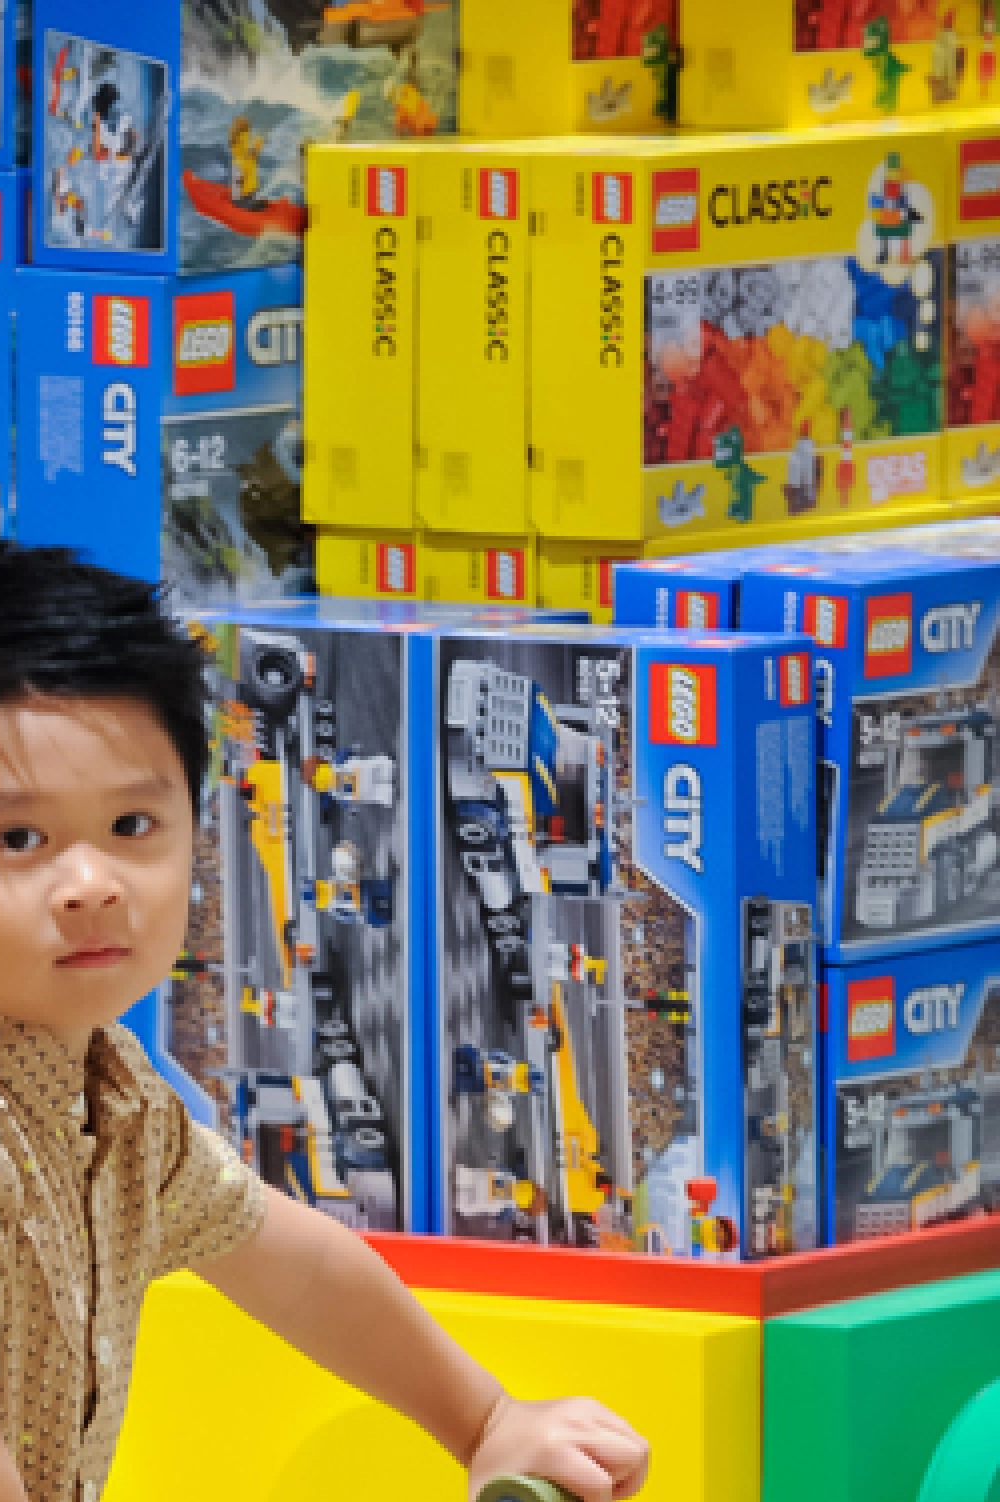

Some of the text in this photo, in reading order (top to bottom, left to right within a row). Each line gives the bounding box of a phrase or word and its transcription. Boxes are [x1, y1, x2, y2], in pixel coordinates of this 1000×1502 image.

[378, 167, 397, 214] LEGO
[490, 170, 509, 217] LEGO
[603, 174, 622, 221] LEGO
[178, 306, 304, 368] LEGO CIT
[102, 297, 138, 477] LEGO CITY
[170, 433, 226, 474] 6-12
[687, 591, 710, 632] LEG
[920, 602, 982, 653] CITY
[597, 658, 621, 727] 5-12
[662, 666, 704, 873] LEGO CITY
[904, 982, 965, 1035] CITY
